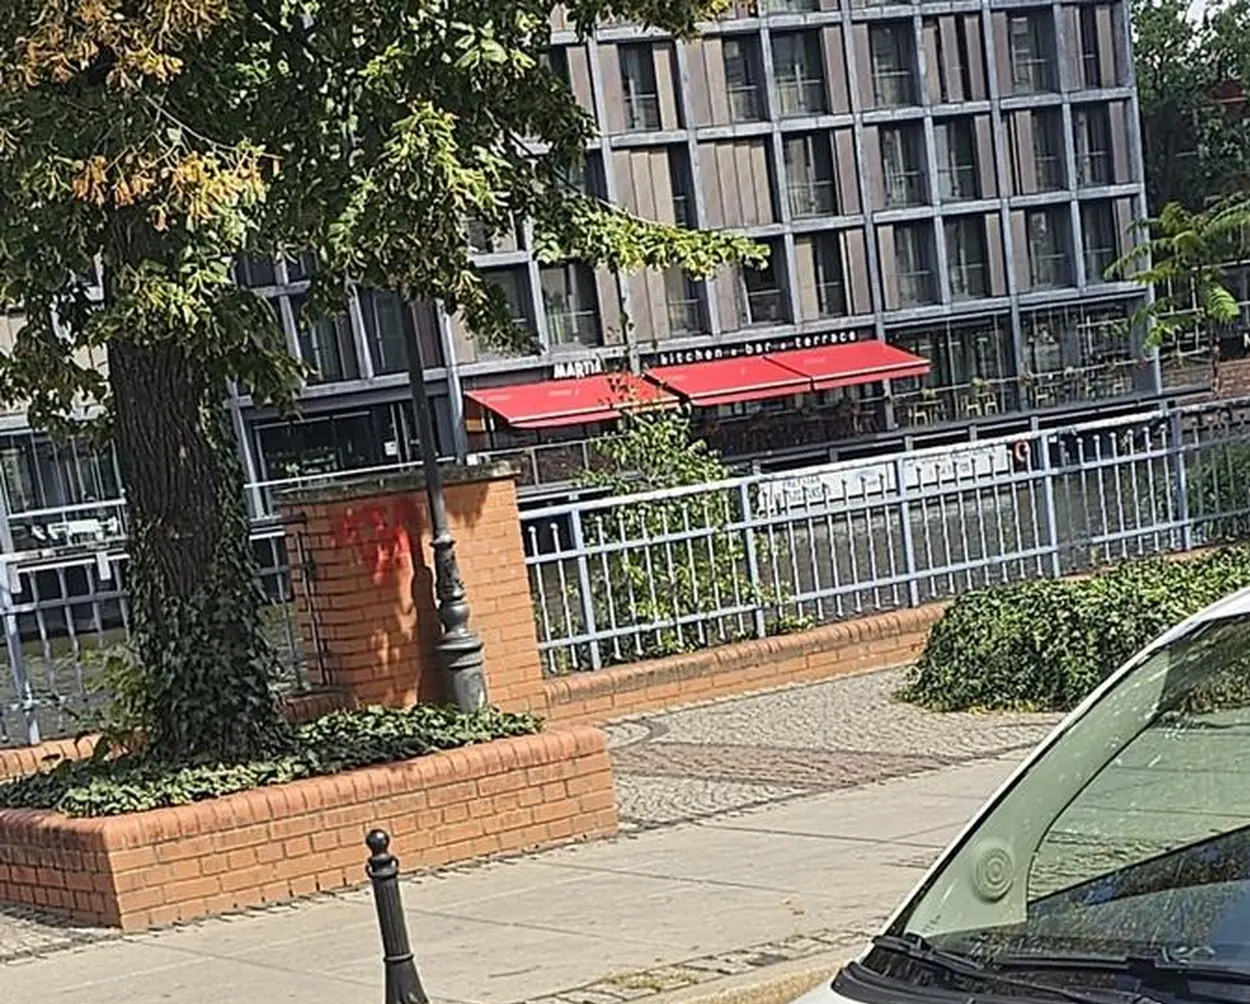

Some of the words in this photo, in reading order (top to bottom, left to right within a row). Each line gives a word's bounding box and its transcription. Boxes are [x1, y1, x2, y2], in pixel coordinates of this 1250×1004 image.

[660, 348, 723, 366] kitchen
[745, 341, 772, 355] bar
[795, 330, 857, 347] terrace
